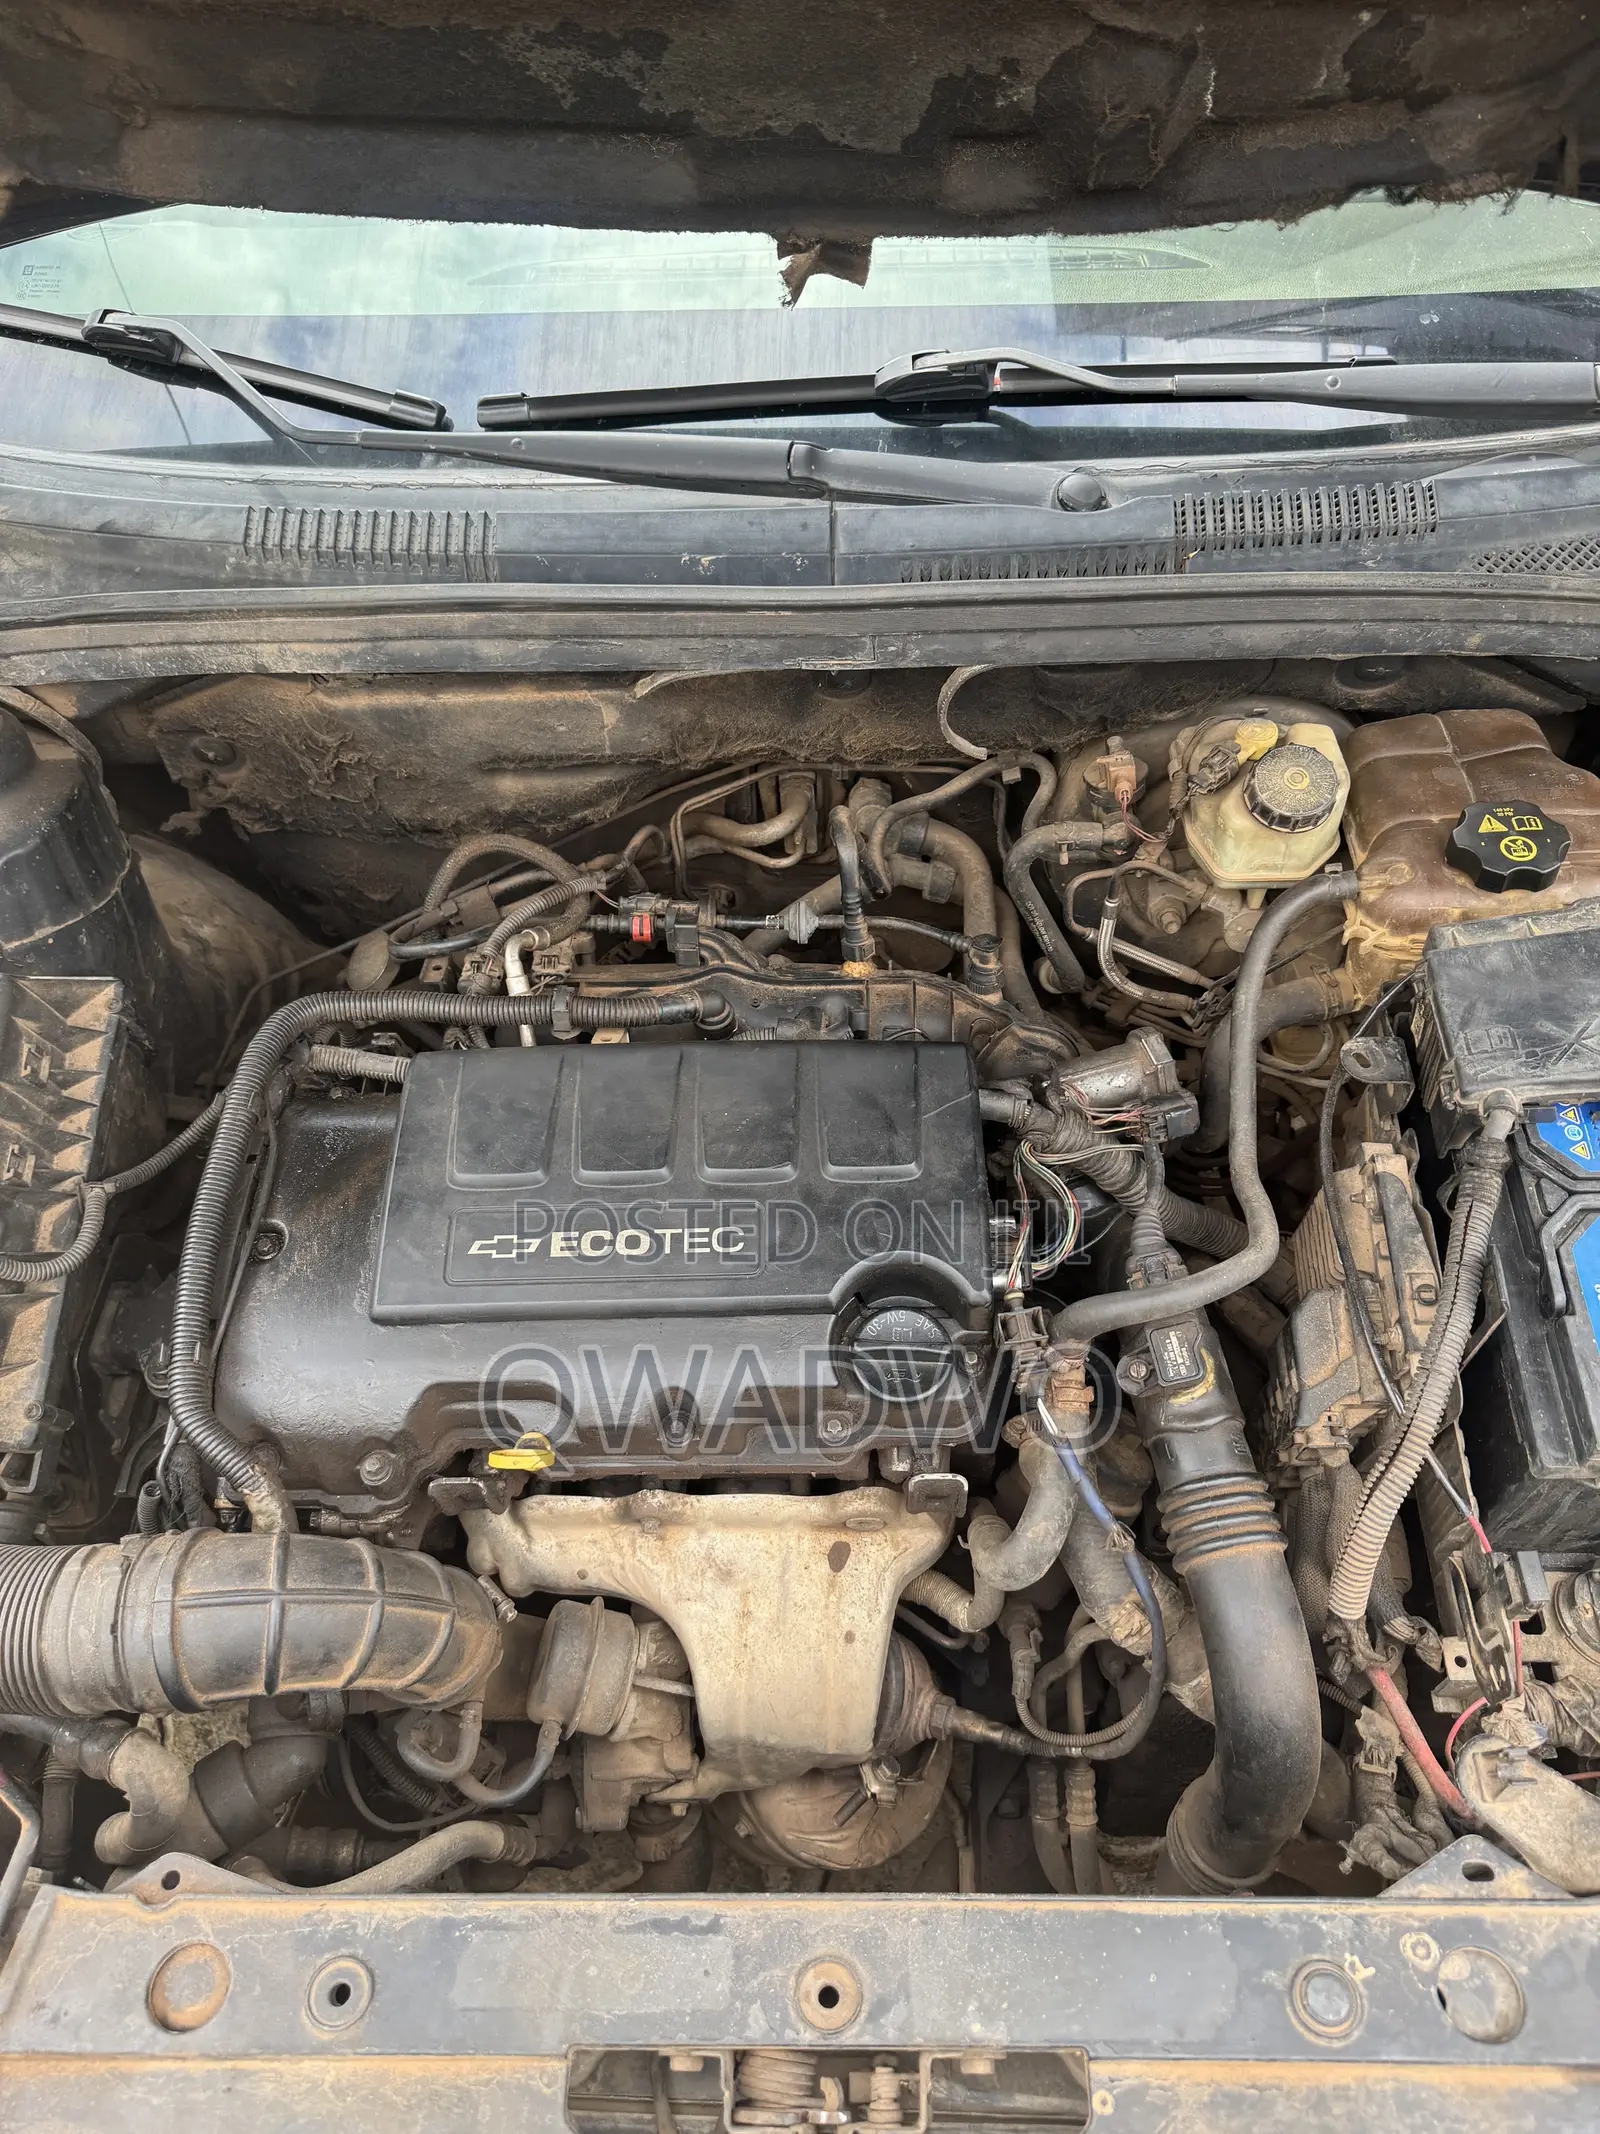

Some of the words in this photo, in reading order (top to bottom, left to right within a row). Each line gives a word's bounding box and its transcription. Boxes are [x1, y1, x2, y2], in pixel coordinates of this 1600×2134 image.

[550, 1226, 745, 1258] ECOTEC
[866, 1309, 906, 1336] 5W-30
[915, 1314, 942, 1339] SAE
